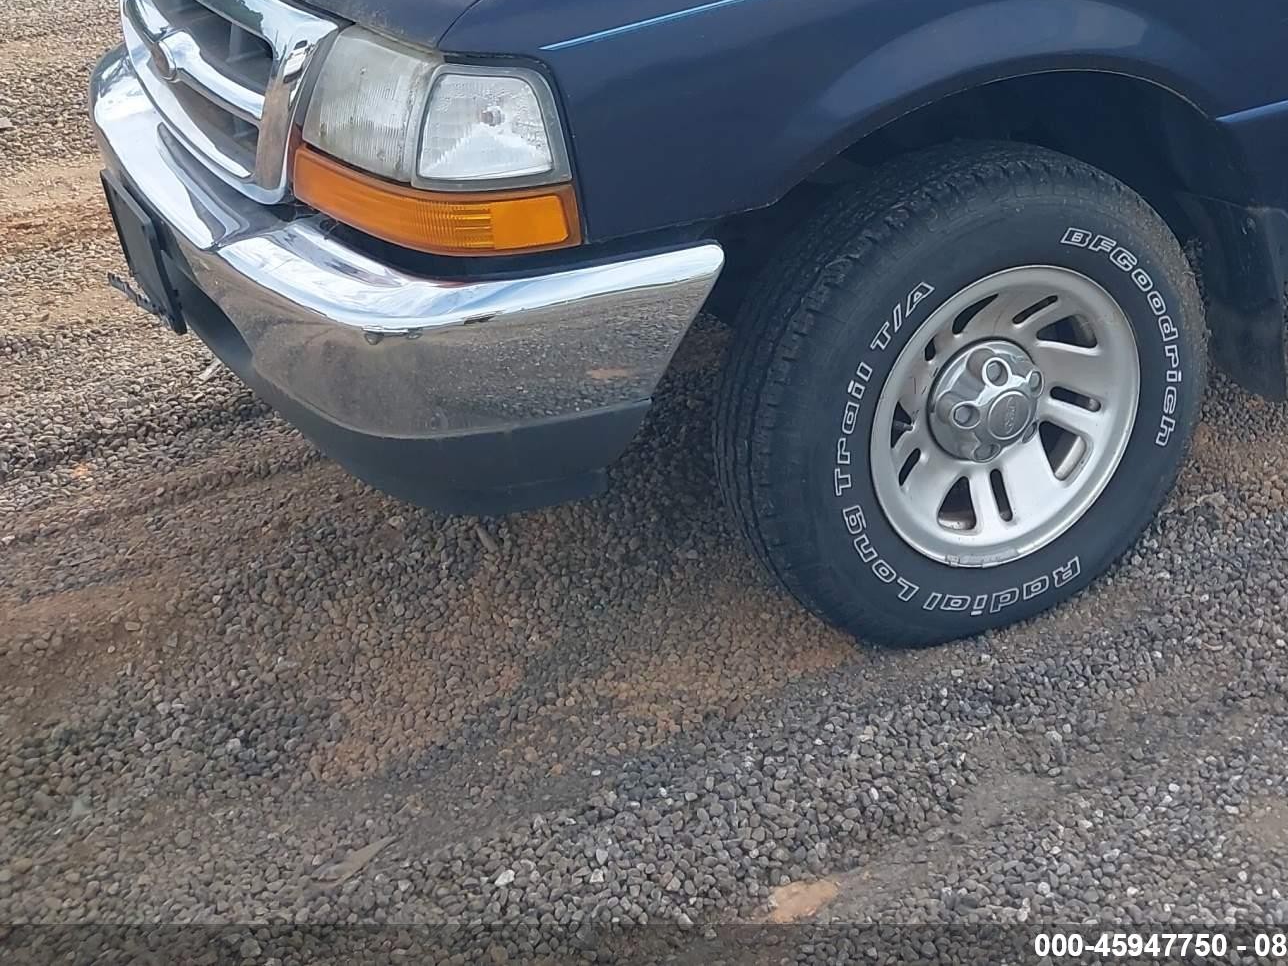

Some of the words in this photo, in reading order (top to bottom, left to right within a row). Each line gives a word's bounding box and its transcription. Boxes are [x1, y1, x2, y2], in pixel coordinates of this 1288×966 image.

[870, 282, 935, 351] T/A
[1060, 227, 1182, 447] BFGoodrich
[834, 361, 873, 497] Trail
[842, 505, 920, 602] Long
[923, 556, 1082, 616] Radial
